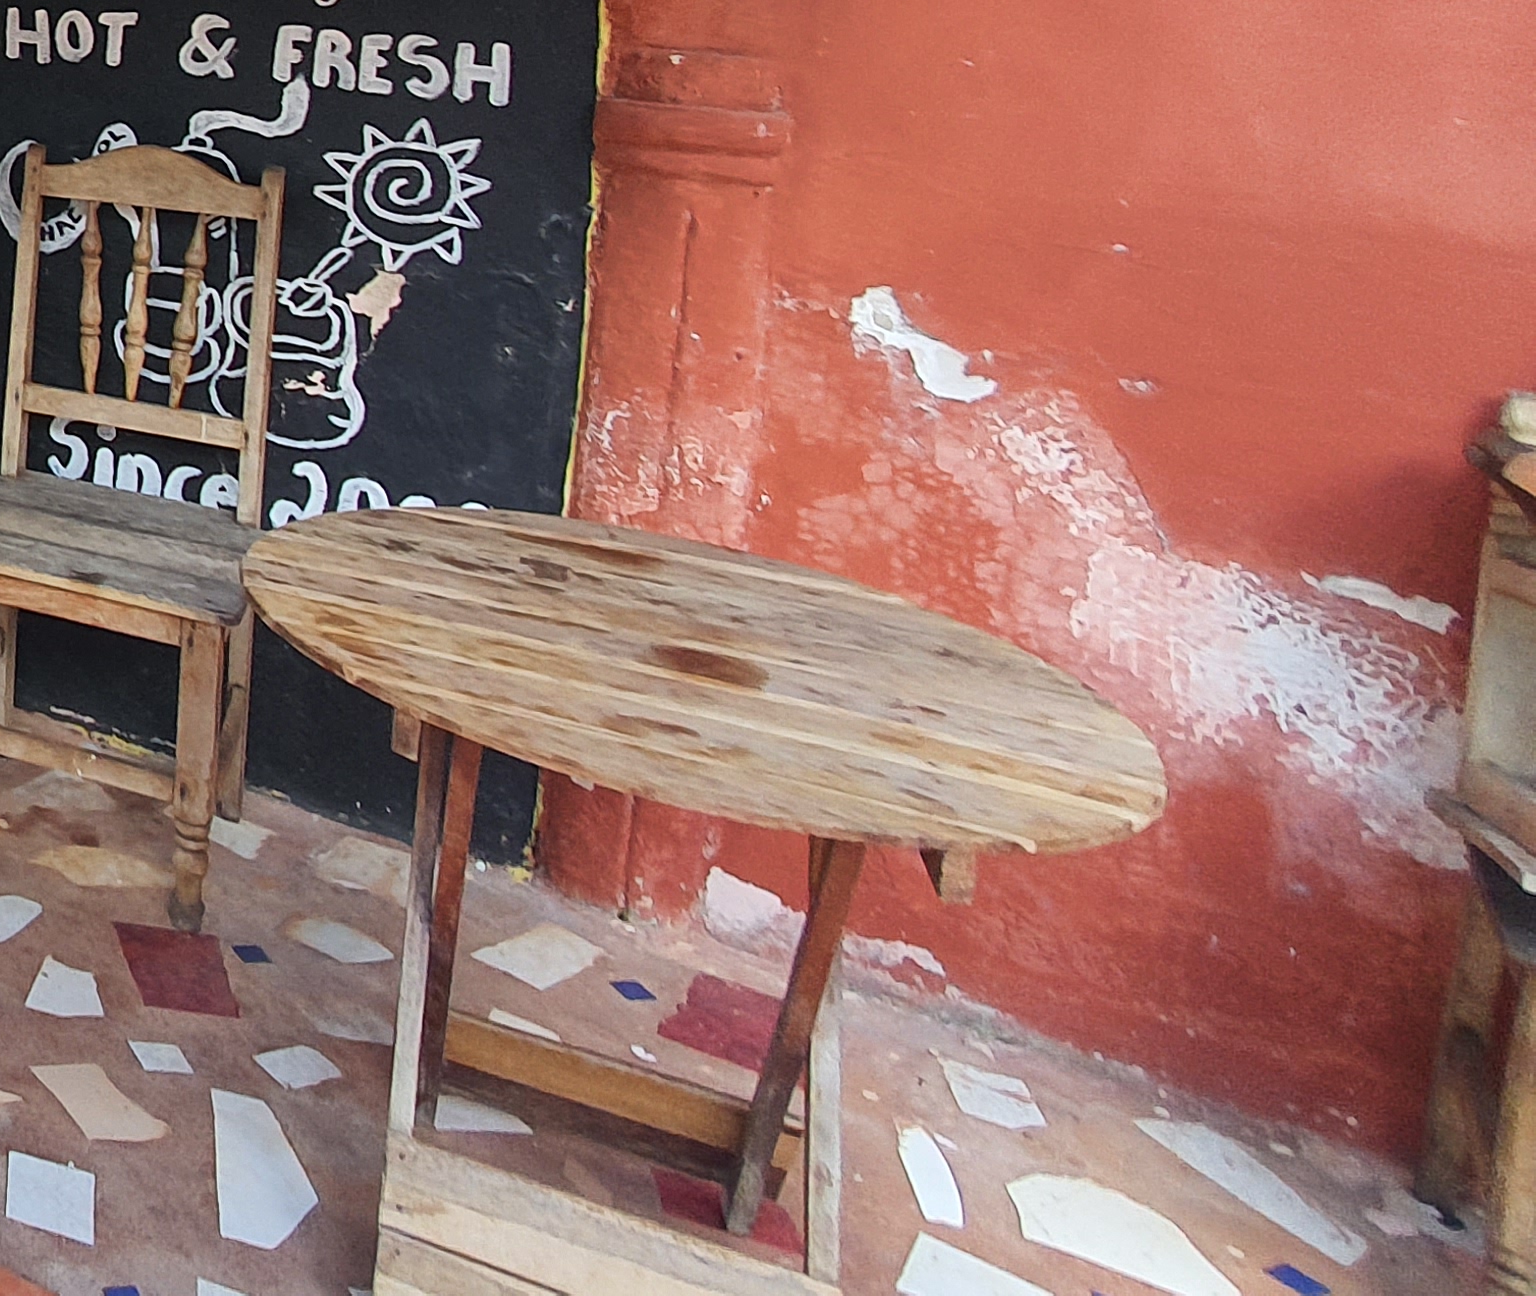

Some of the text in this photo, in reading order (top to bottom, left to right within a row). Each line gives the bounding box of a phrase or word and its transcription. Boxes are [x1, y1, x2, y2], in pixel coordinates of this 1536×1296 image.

[4, 6, 513, 107] HOT & FRESH
[97, 130, 127, 154] OL
[39, 206, 83, 242] HAC
[46, 416, 240, 510] Since
